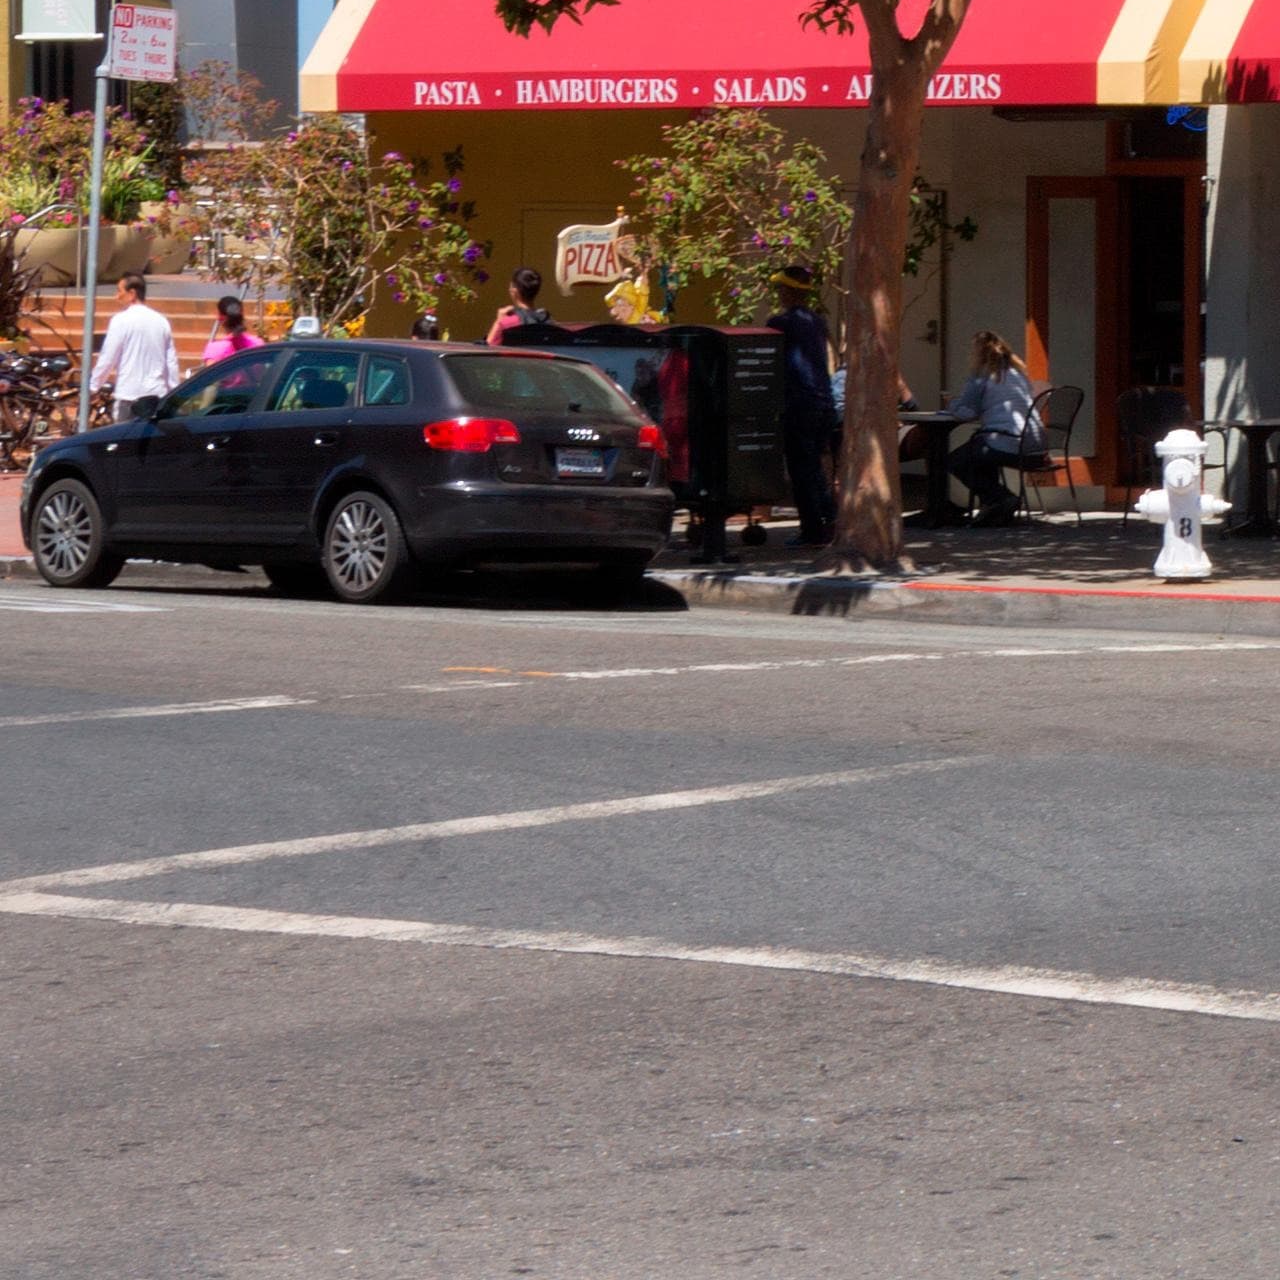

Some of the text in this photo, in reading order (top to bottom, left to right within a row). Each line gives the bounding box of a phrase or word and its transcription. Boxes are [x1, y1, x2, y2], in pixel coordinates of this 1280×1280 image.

[116, 7, 172, 30] NO PARKING
[414, 81, 481, 105] PASTA
[516, 78, 678, 104] HAMBURGERS
[714, 76, 807, 103] SALADS
[563, 243, 618, 282] PIZZA
[1180, 517, 1192, 537] 8
